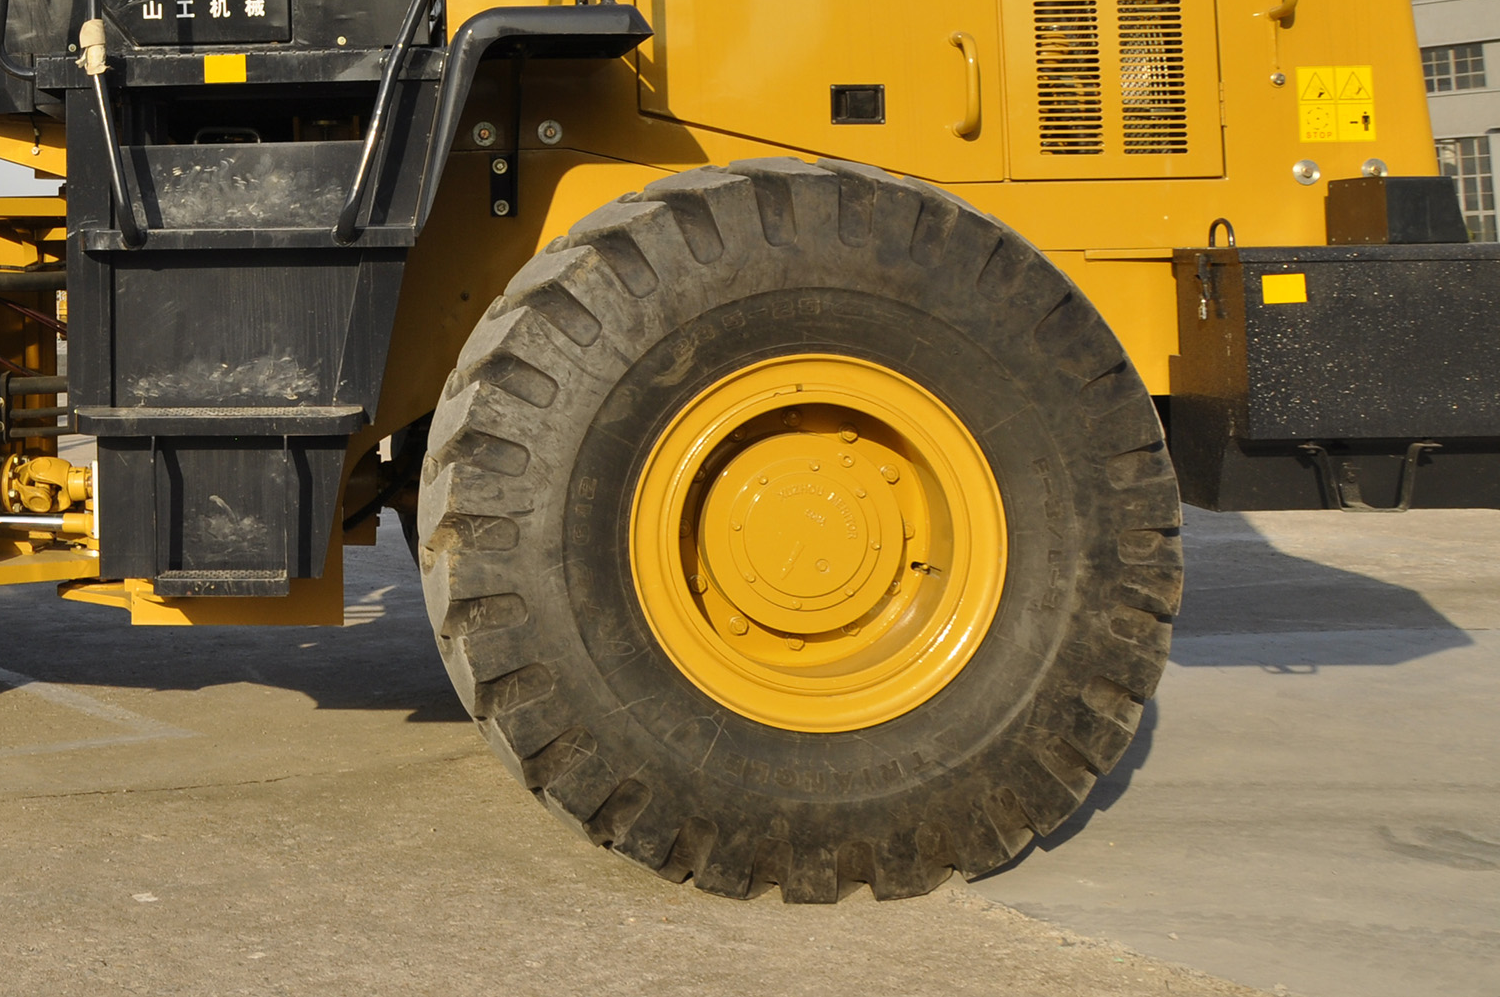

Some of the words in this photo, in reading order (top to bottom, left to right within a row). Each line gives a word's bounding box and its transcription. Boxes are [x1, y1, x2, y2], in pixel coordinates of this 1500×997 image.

[778, 483, 825, 502] XUZHOU
[827, 492, 859, 540] MERITOR
[724, 751, 933, 793] TRIANGLE
